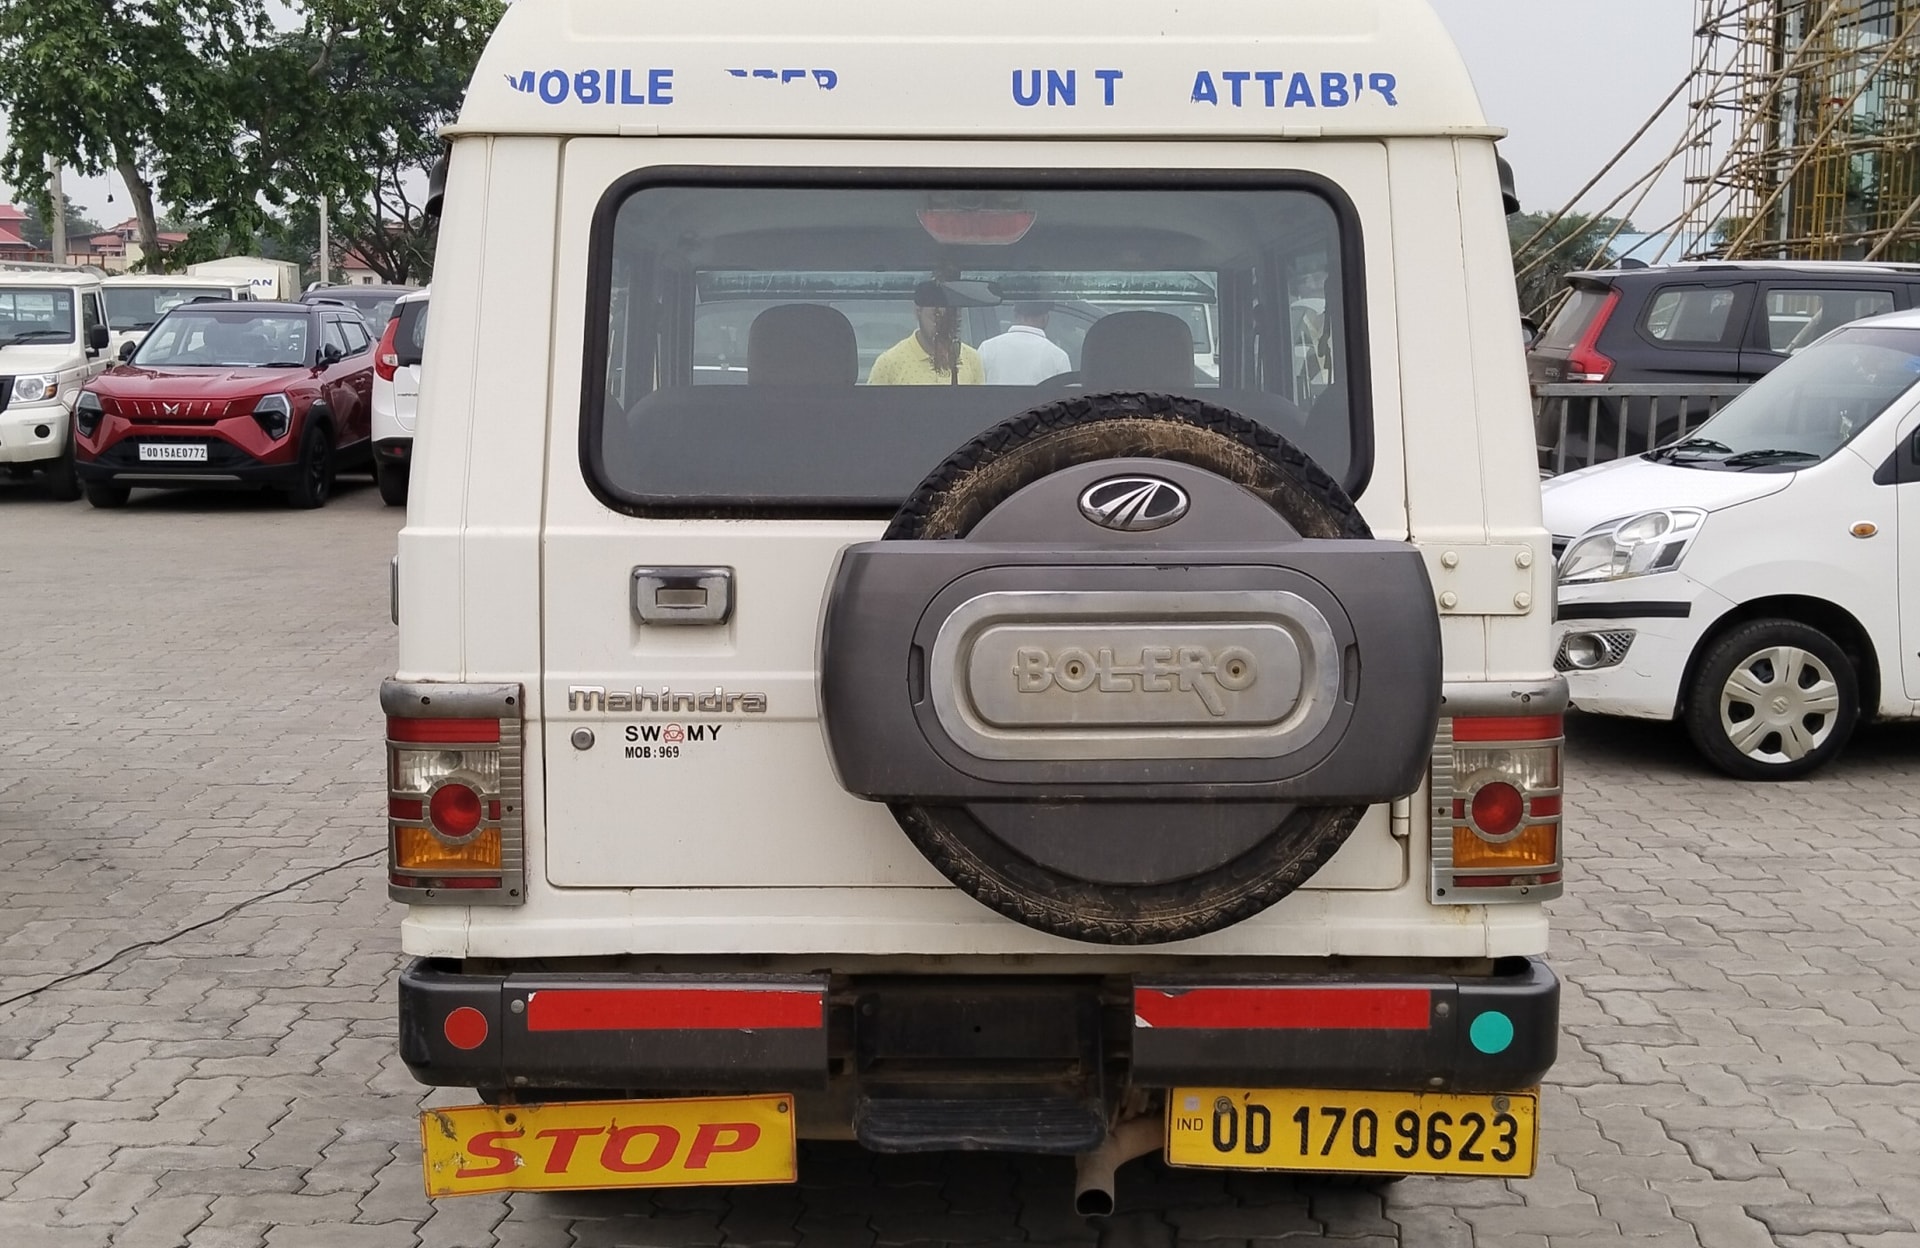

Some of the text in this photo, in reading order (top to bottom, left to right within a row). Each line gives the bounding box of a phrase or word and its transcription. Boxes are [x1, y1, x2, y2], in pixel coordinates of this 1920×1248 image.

[1013, 648, 1257, 716] BOLERO
[456, 1122, 761, 1179] STOP
[1177, 1117, 1203, 1131] IND
[1394, 1109, 1518, 1162] 9623
